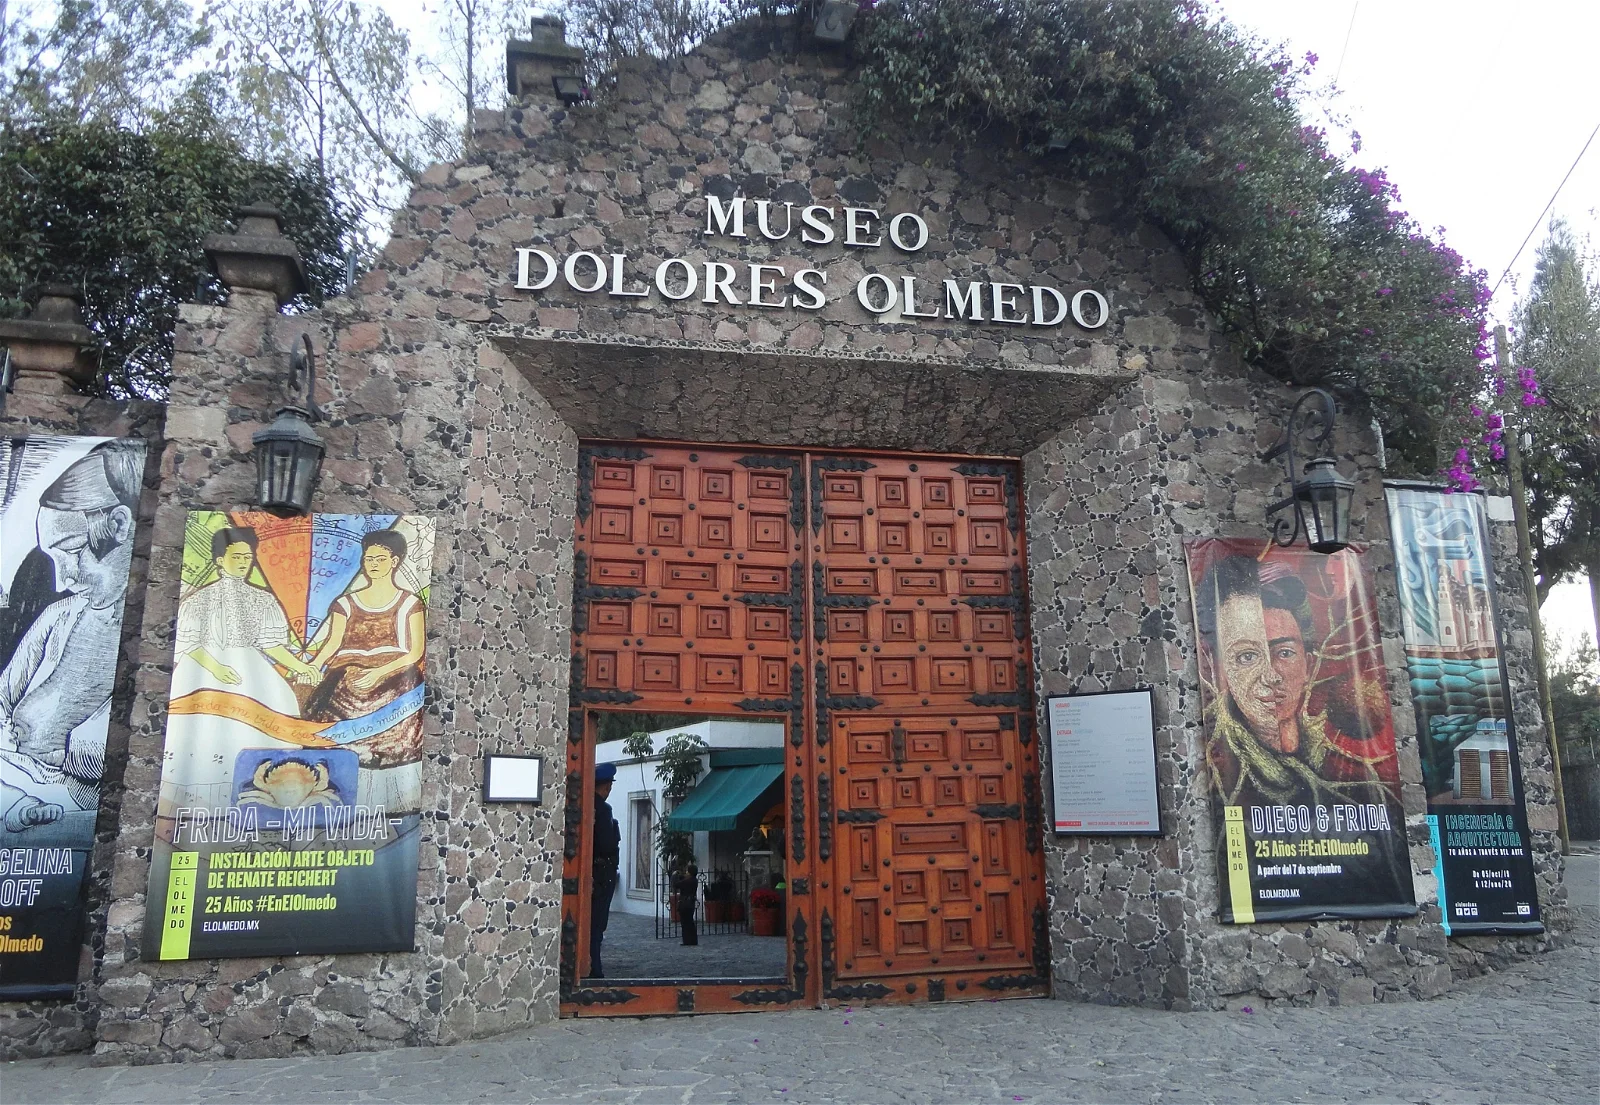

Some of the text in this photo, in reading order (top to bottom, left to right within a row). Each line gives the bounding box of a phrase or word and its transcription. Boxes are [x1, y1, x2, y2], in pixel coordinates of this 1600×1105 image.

[704, 194, 930, 251] MUSEO
[514, 248, 1110, 329] DOLORES OLMEDO
[173, 804, 402, 843] FRIDA -MI VIDA-
[1250, 804, 1391, 833] DIEGO & FRIDA
[1445, 812, 1514, 830] INGENIERÍA &
[1230, 827, 1240, 835] EL
[1232, 839, 1240, 847] OL
[1448, 832, 1522, 846] ARQUITECTURA
[1254, 838, 1369, 858] 25 Años #EnElOlmedo
[1458, 847, 1472, 856] AÑOS
[1473, 848, 1477, 856] A
[1478, 847, 1498, 856] TRAVÉS
[1500, 848, 1509, 856] DEL
[1511, 848, 1524, 856] ARTE
[178, 856, 190, 865] 25
[210, 848, 374, 869] INSTALACIÓN ARTE OBJETO
[1233, 862, 1244, 870] DO
[1257, 863, 1342, 878] A partir del 7 de septiembre
[174, 876, 188, 886] EL
[208, 870, 338, 889] DE RENATE REICHERT
[0, 879, 43, 906] OFF
[173, 890, 187, 900] OL
[1260, 889, 1300, 899] ELOLMEDO.MX
[170, 904, 186, 915] ME
[205, 893, 337, 914] 25 Años #EnElOlmedo
[170, 920, 185, 929] DO
[203, 920, 260, 932] ELOLMEDO.MX
